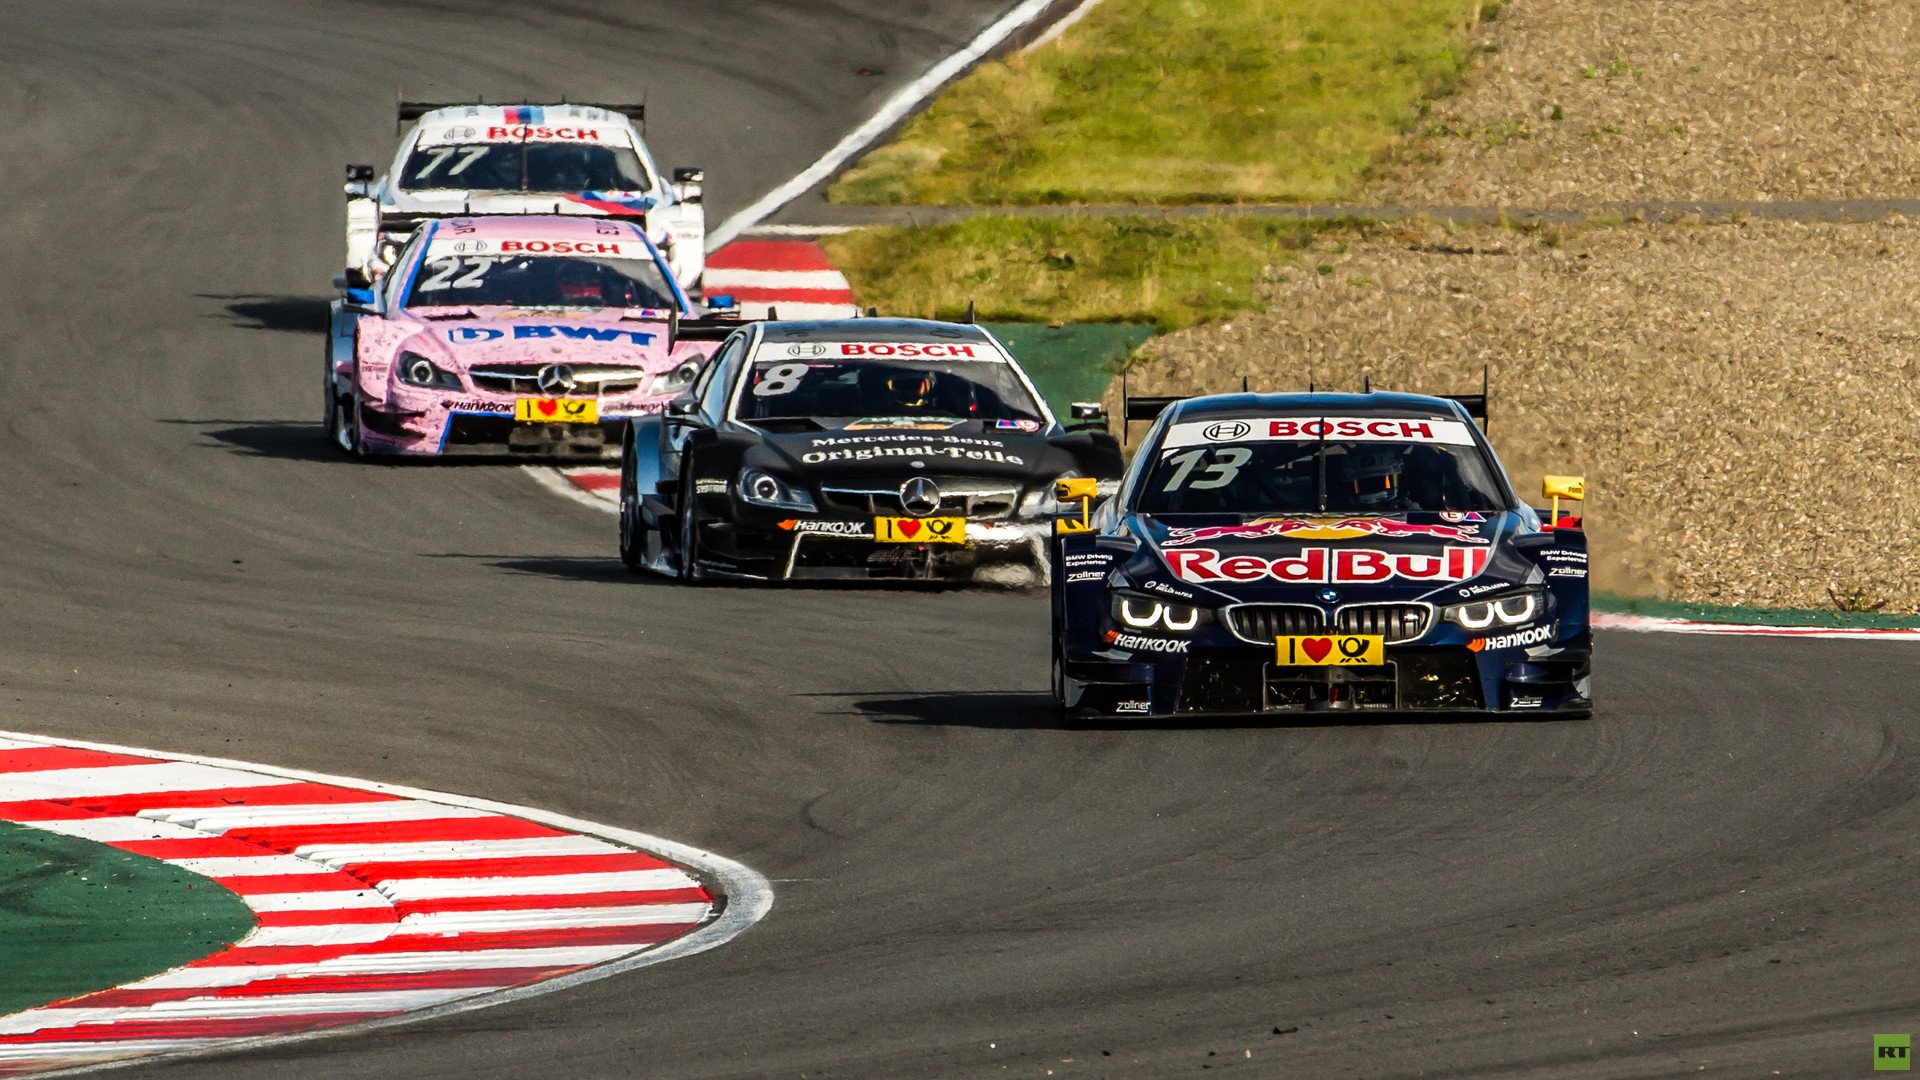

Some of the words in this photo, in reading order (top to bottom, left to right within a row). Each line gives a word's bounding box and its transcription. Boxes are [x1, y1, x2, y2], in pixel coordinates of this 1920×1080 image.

[488, 126, 599, 140] BOSCH
[415, 146, 491, 180] 77
[501, 240, 621, 255] BOSCH
[418, 255, 499, 293] 22
[513, 325, 657, 346] BWT
[841, 343, 975, 358] BOSCH
[753, 362, 810, 397] 8
[1269, 420, 1434, 438] BOSCH
[811, 434, 1005, 448] Mercedes-Benz
[1162, 447, 1253, 492] 13
[1066, 559, 1107, 567] Experience
[1087, 553, 1113, 561] Driving
[1546, 555, 1587, 563] Experience
